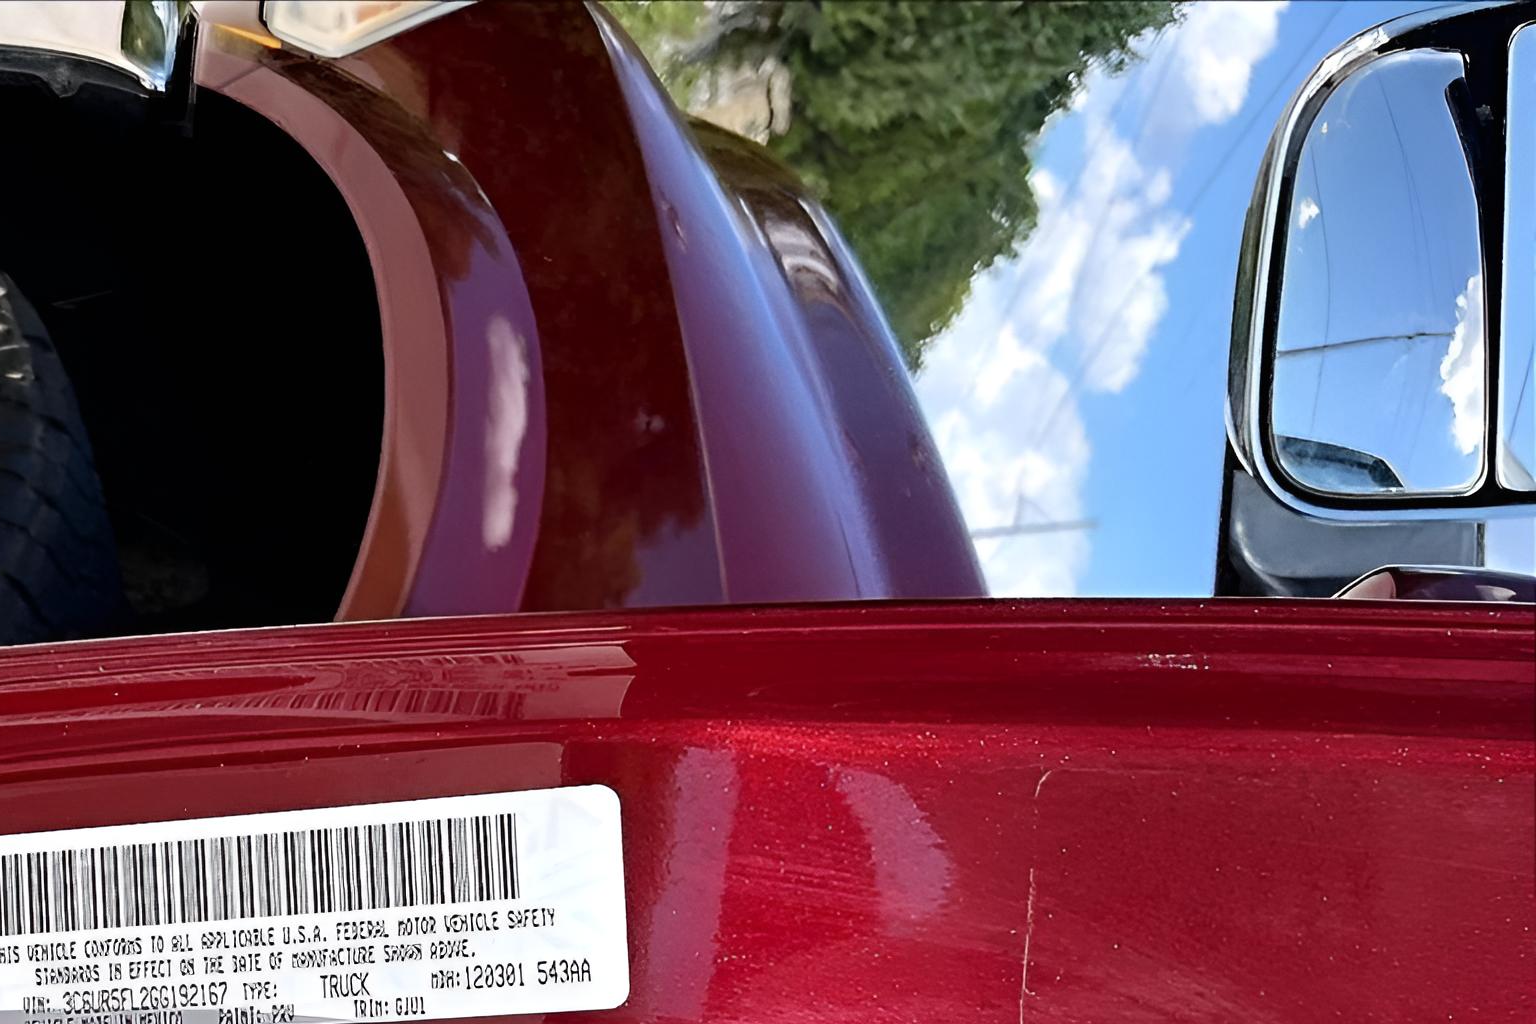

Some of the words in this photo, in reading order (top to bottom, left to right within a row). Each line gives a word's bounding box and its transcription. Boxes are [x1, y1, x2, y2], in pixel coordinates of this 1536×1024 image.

[27, 941, 77, 962] VEHICLE
[150, 935, 164, 953] TO
[282, 925, 327, 945] U.S.A.
[336, 920, 390, 941] FEDERAL
[397, 915, 437, 937] MOTOR
[443, 910, 500, 933] VEHICLE
[507, 907, 555, 930] SAFETY
[62, 981, 228, 1015] 3C6UR5FL2GG192167
[242, 981, 277, 1001] TYPE:
[319, 972, 371, 999] TRUCK
[537, 958, 592, 985] 543AA
[128, 959, 172, 980] EFFECT
[268, 951, 283, 971] OF
